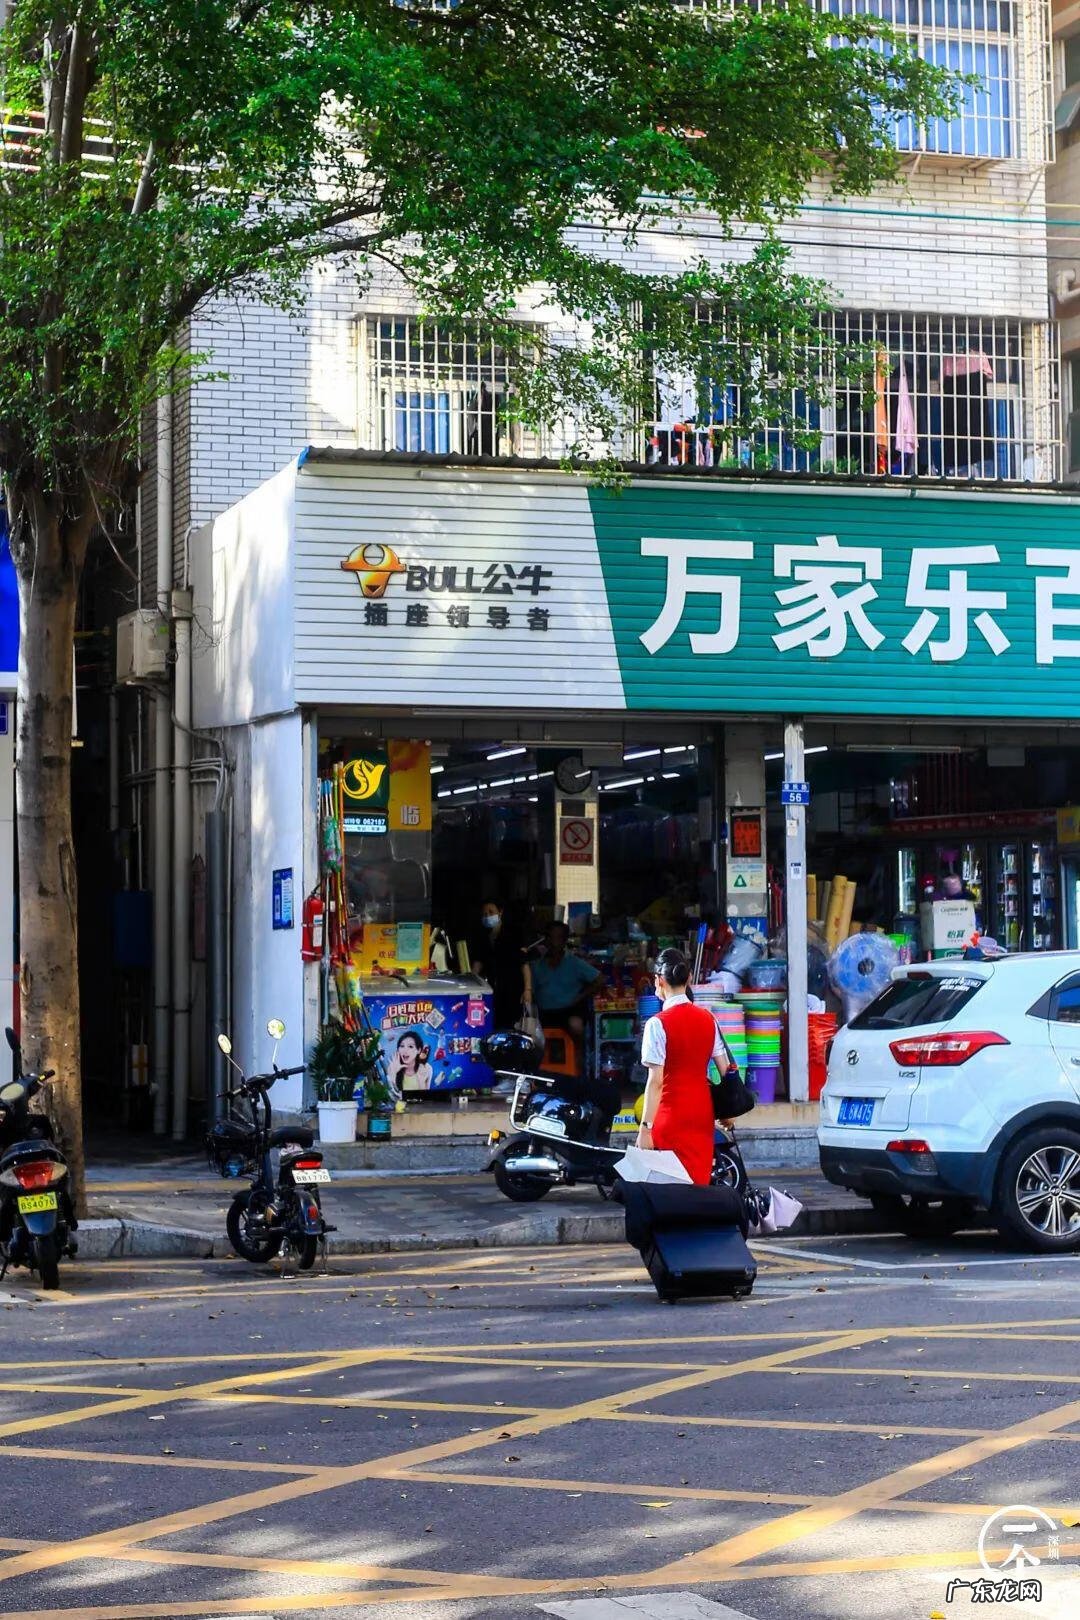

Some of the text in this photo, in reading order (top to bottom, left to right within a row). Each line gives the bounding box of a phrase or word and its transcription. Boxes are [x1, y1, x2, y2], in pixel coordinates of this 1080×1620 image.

[364, 602, 551, 631] 插座领导者
[789, 792, 802, 803] 56
